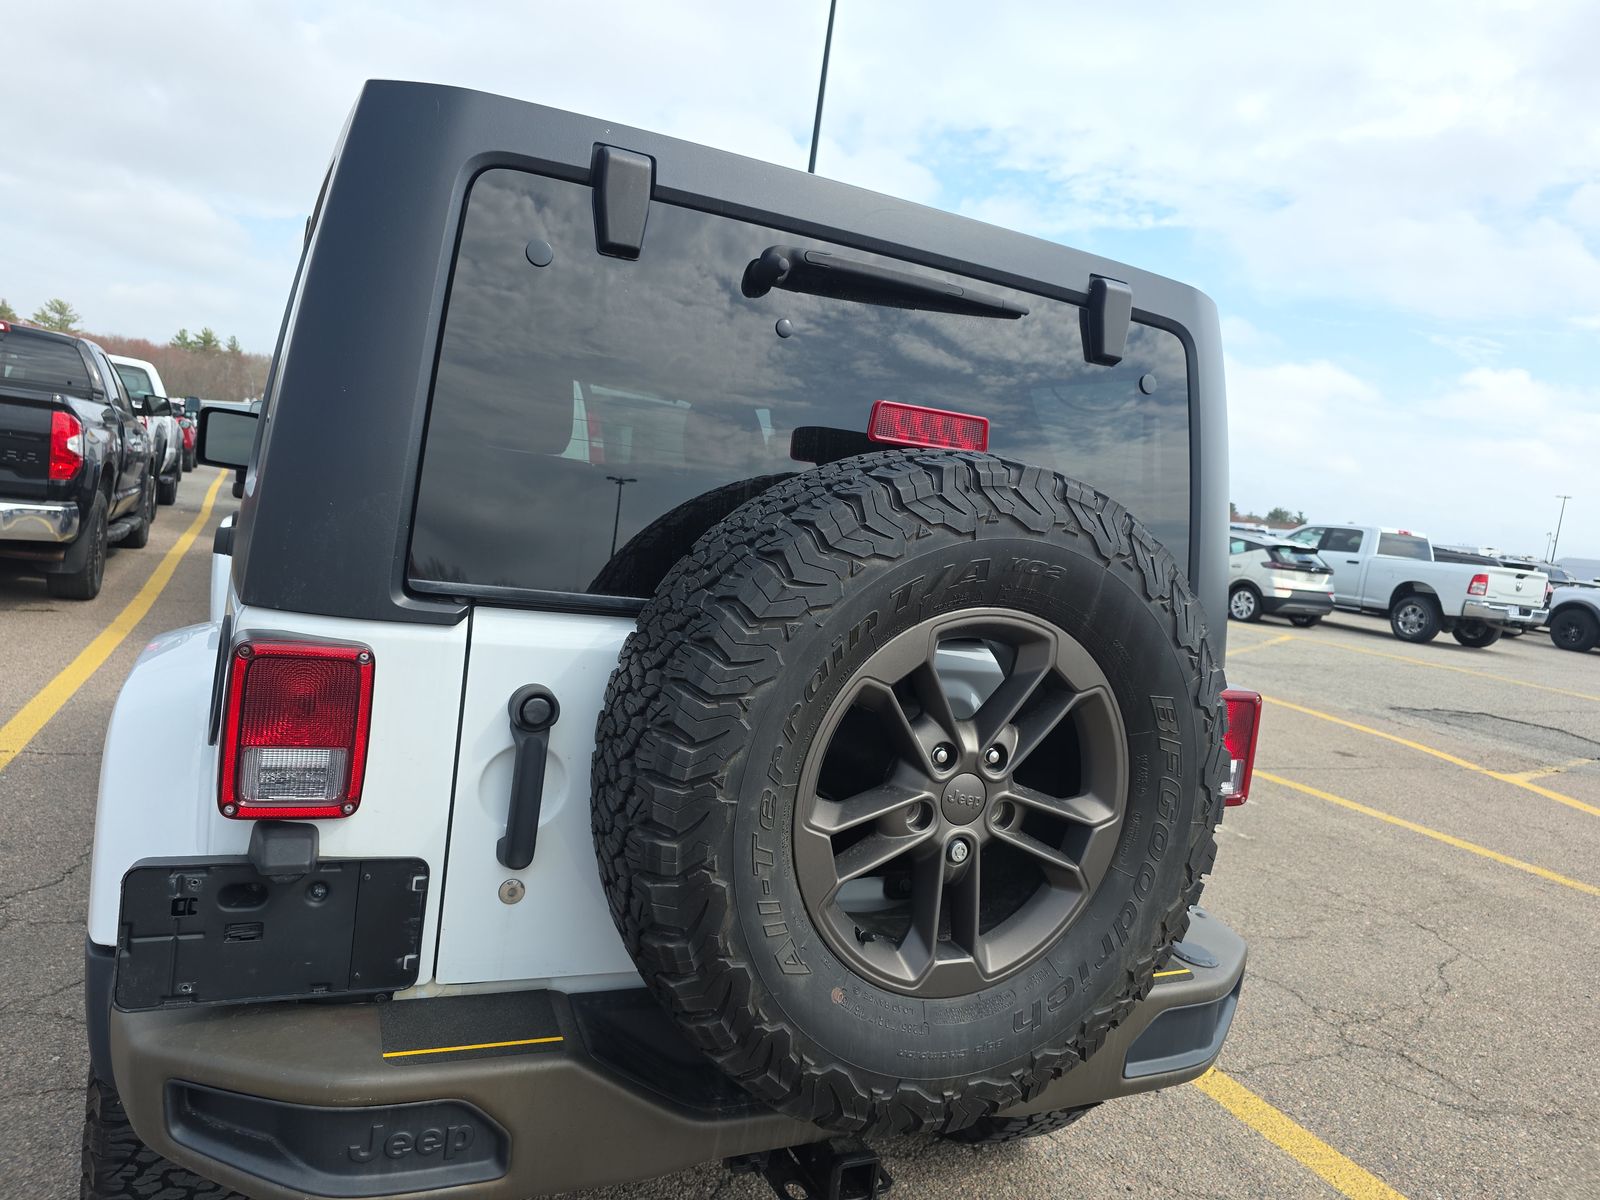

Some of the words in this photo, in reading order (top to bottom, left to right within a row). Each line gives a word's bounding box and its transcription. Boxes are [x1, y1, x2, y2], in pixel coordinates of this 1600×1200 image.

[889, 557, 991, 614] T/A
[947, 789, 981, 809] Jeep
[1012, 695, 1183, 1034] BFGoodrich
[346, 1124, 475, 1162] Jeep
